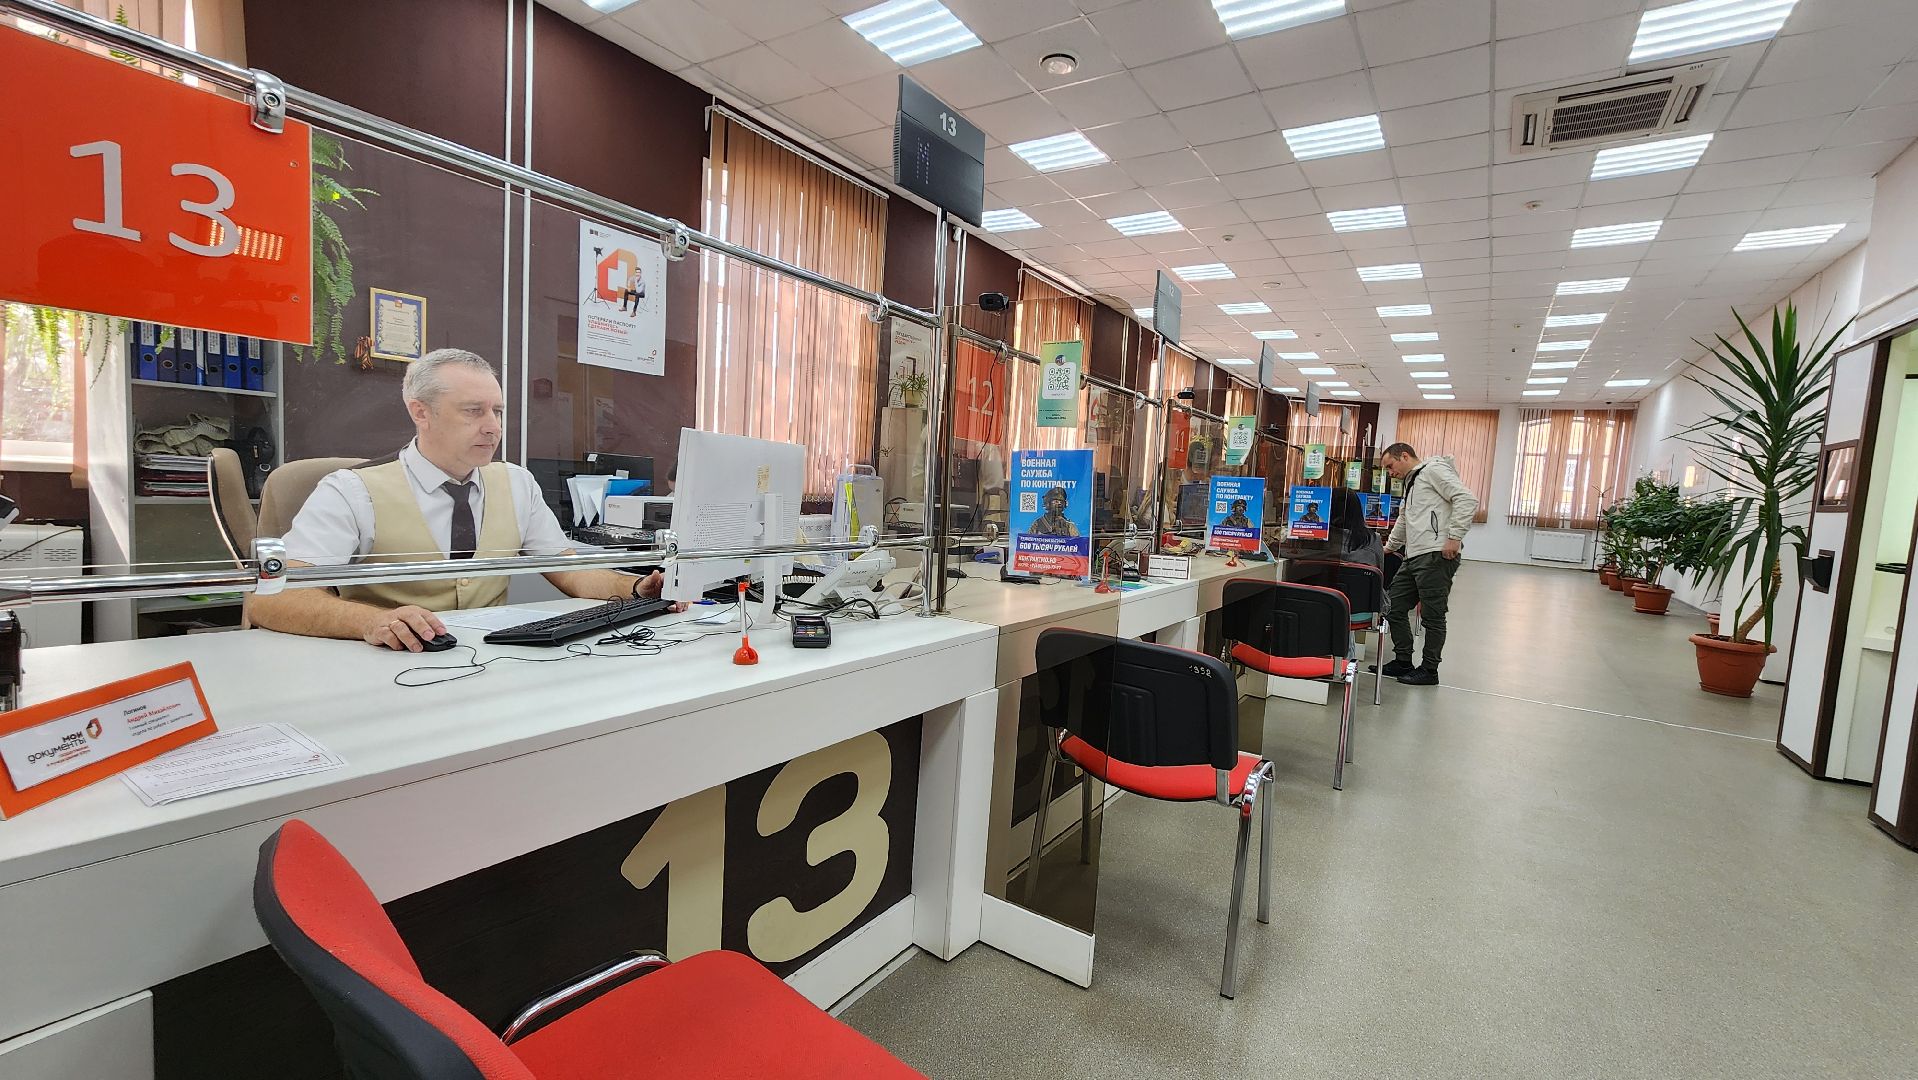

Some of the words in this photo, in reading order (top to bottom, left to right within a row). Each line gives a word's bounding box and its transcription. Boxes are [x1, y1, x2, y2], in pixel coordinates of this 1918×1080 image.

[940, 112, 956, 137] 13
[70, 140, 242, 257] 13
[968, 377, 992, 416] 12
[1175, 430, 1184, 452] 11
[1022, 459, 1056, 468] ВОЕННАЯ
[1021, 469, 1052, 478] СЛУЖБА
[1021, 480, 1031, 488] ПО
[1032, 480, 1077, 489] КОНТРАКТУ
[1032, 543, 1053, 551] ТЫСЯЧ
[1054, 544, 1078, 552] РУБЛЕЙ
[124, 704, 147, 716] Логинов
[127, 712, 148, 724] Андрей
[28, 738, 87, 764] документы
[621, 730, 892, 964] 13
